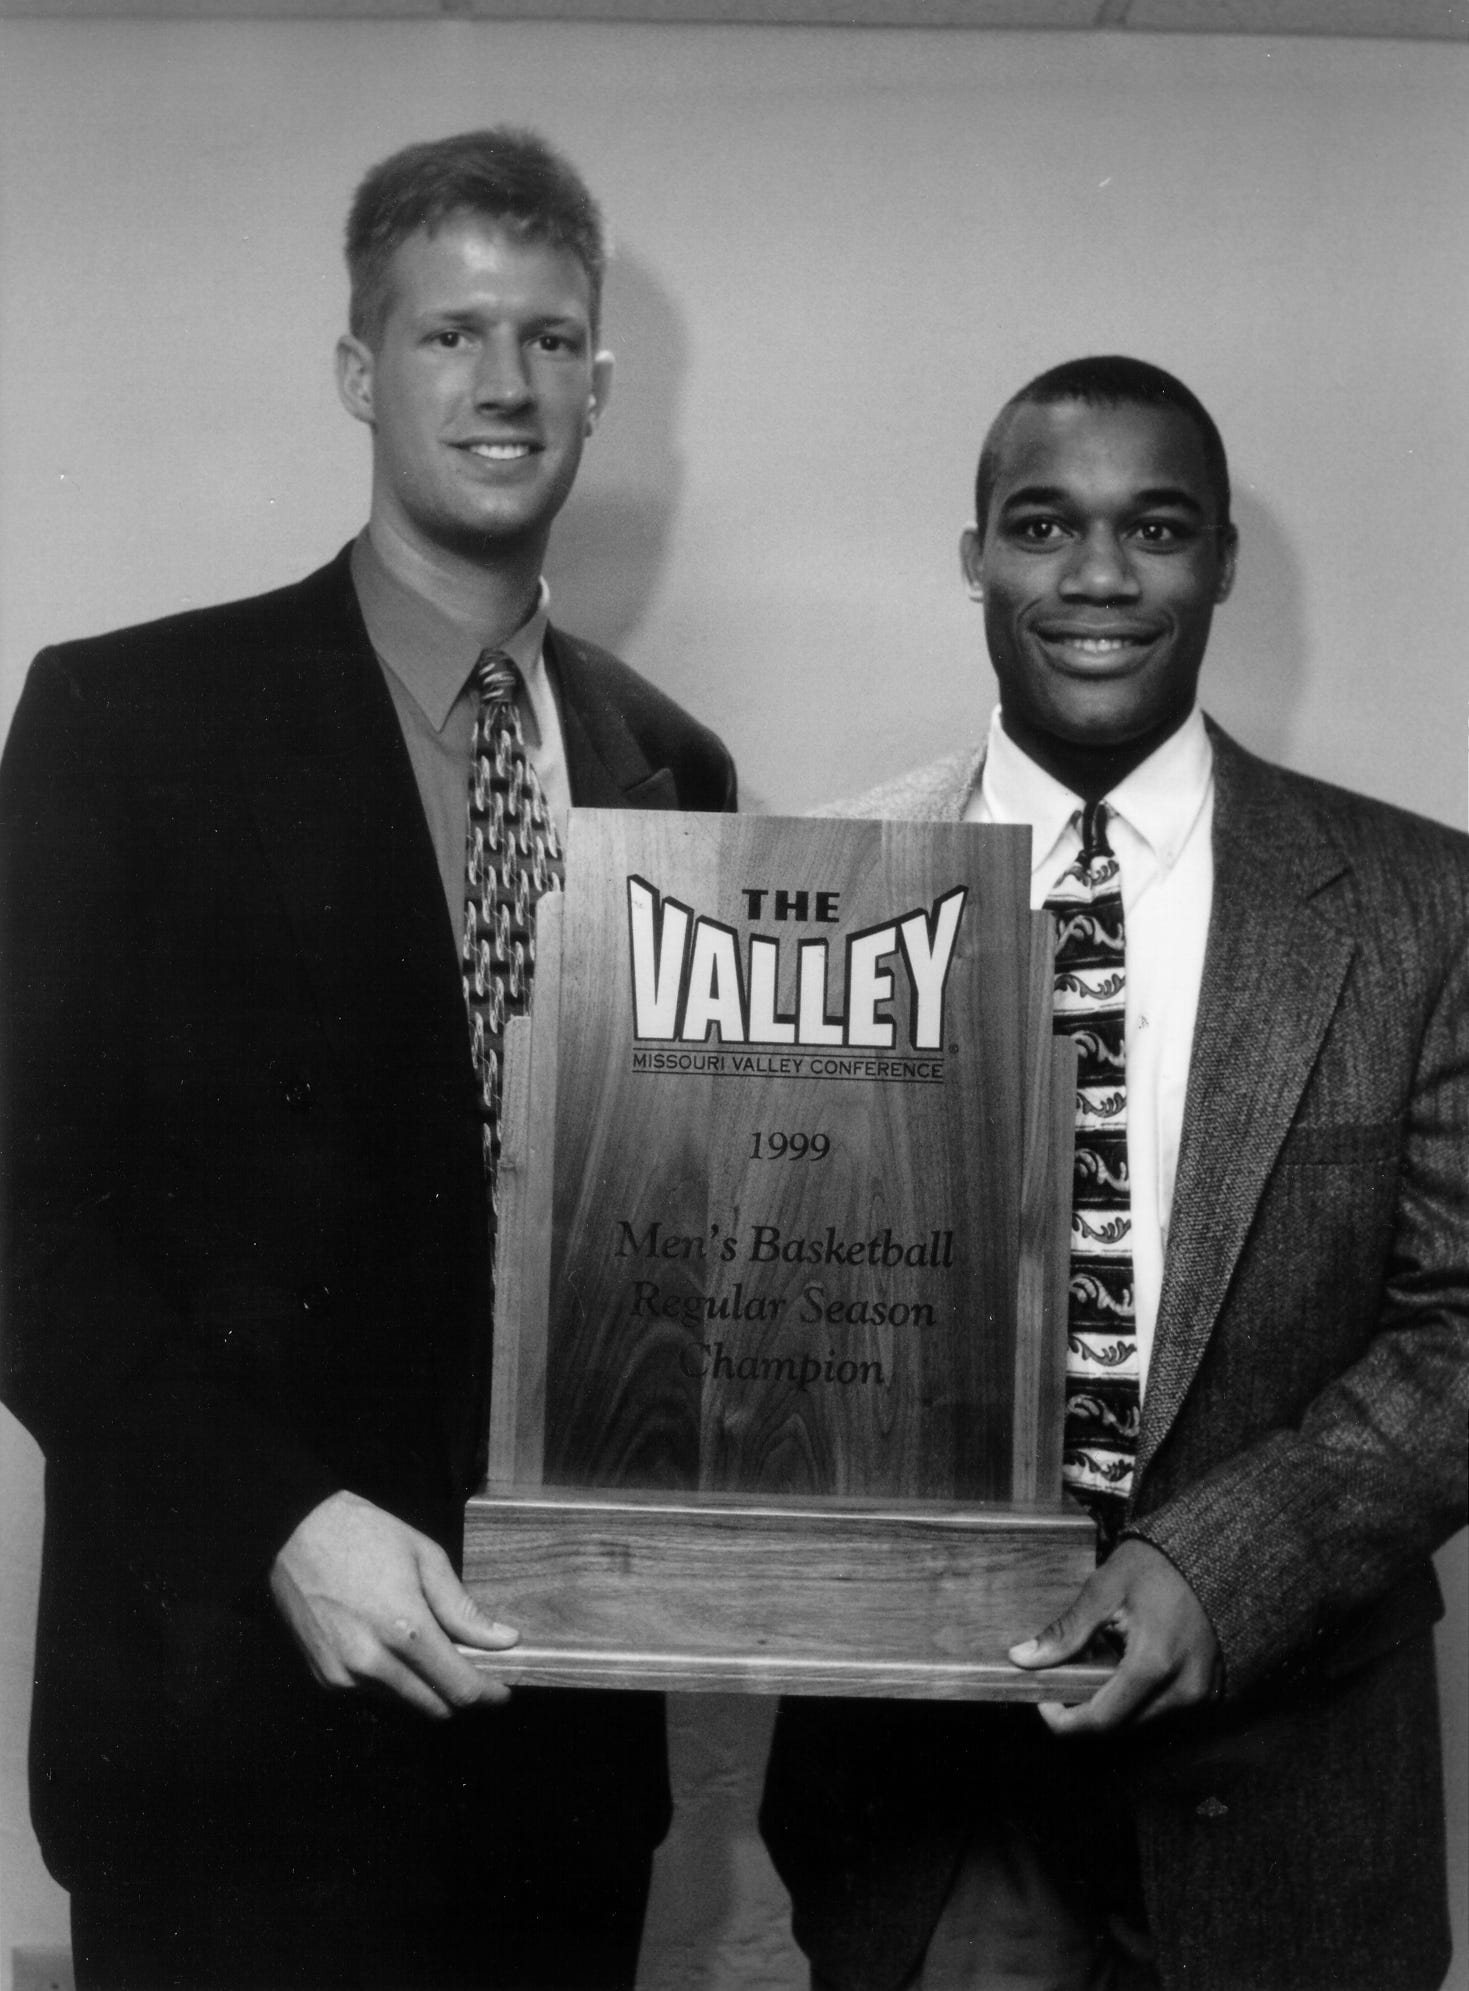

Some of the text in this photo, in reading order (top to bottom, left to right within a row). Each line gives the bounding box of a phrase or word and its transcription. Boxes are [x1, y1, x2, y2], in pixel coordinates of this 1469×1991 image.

[742, 888, 840, 923] THE
[627, 873, 969, 1051] VALLEY
[632, 1053, 944, 1078] MISSOURI VALLEY CONFERENCE
[750, 1131, 831, 1161] 1999
[615, 1220, 954, 1268] Men's Basketball
[630, 1281, 936, 1328] Regular Season
[679, 1341, 885, 1393] Champion
